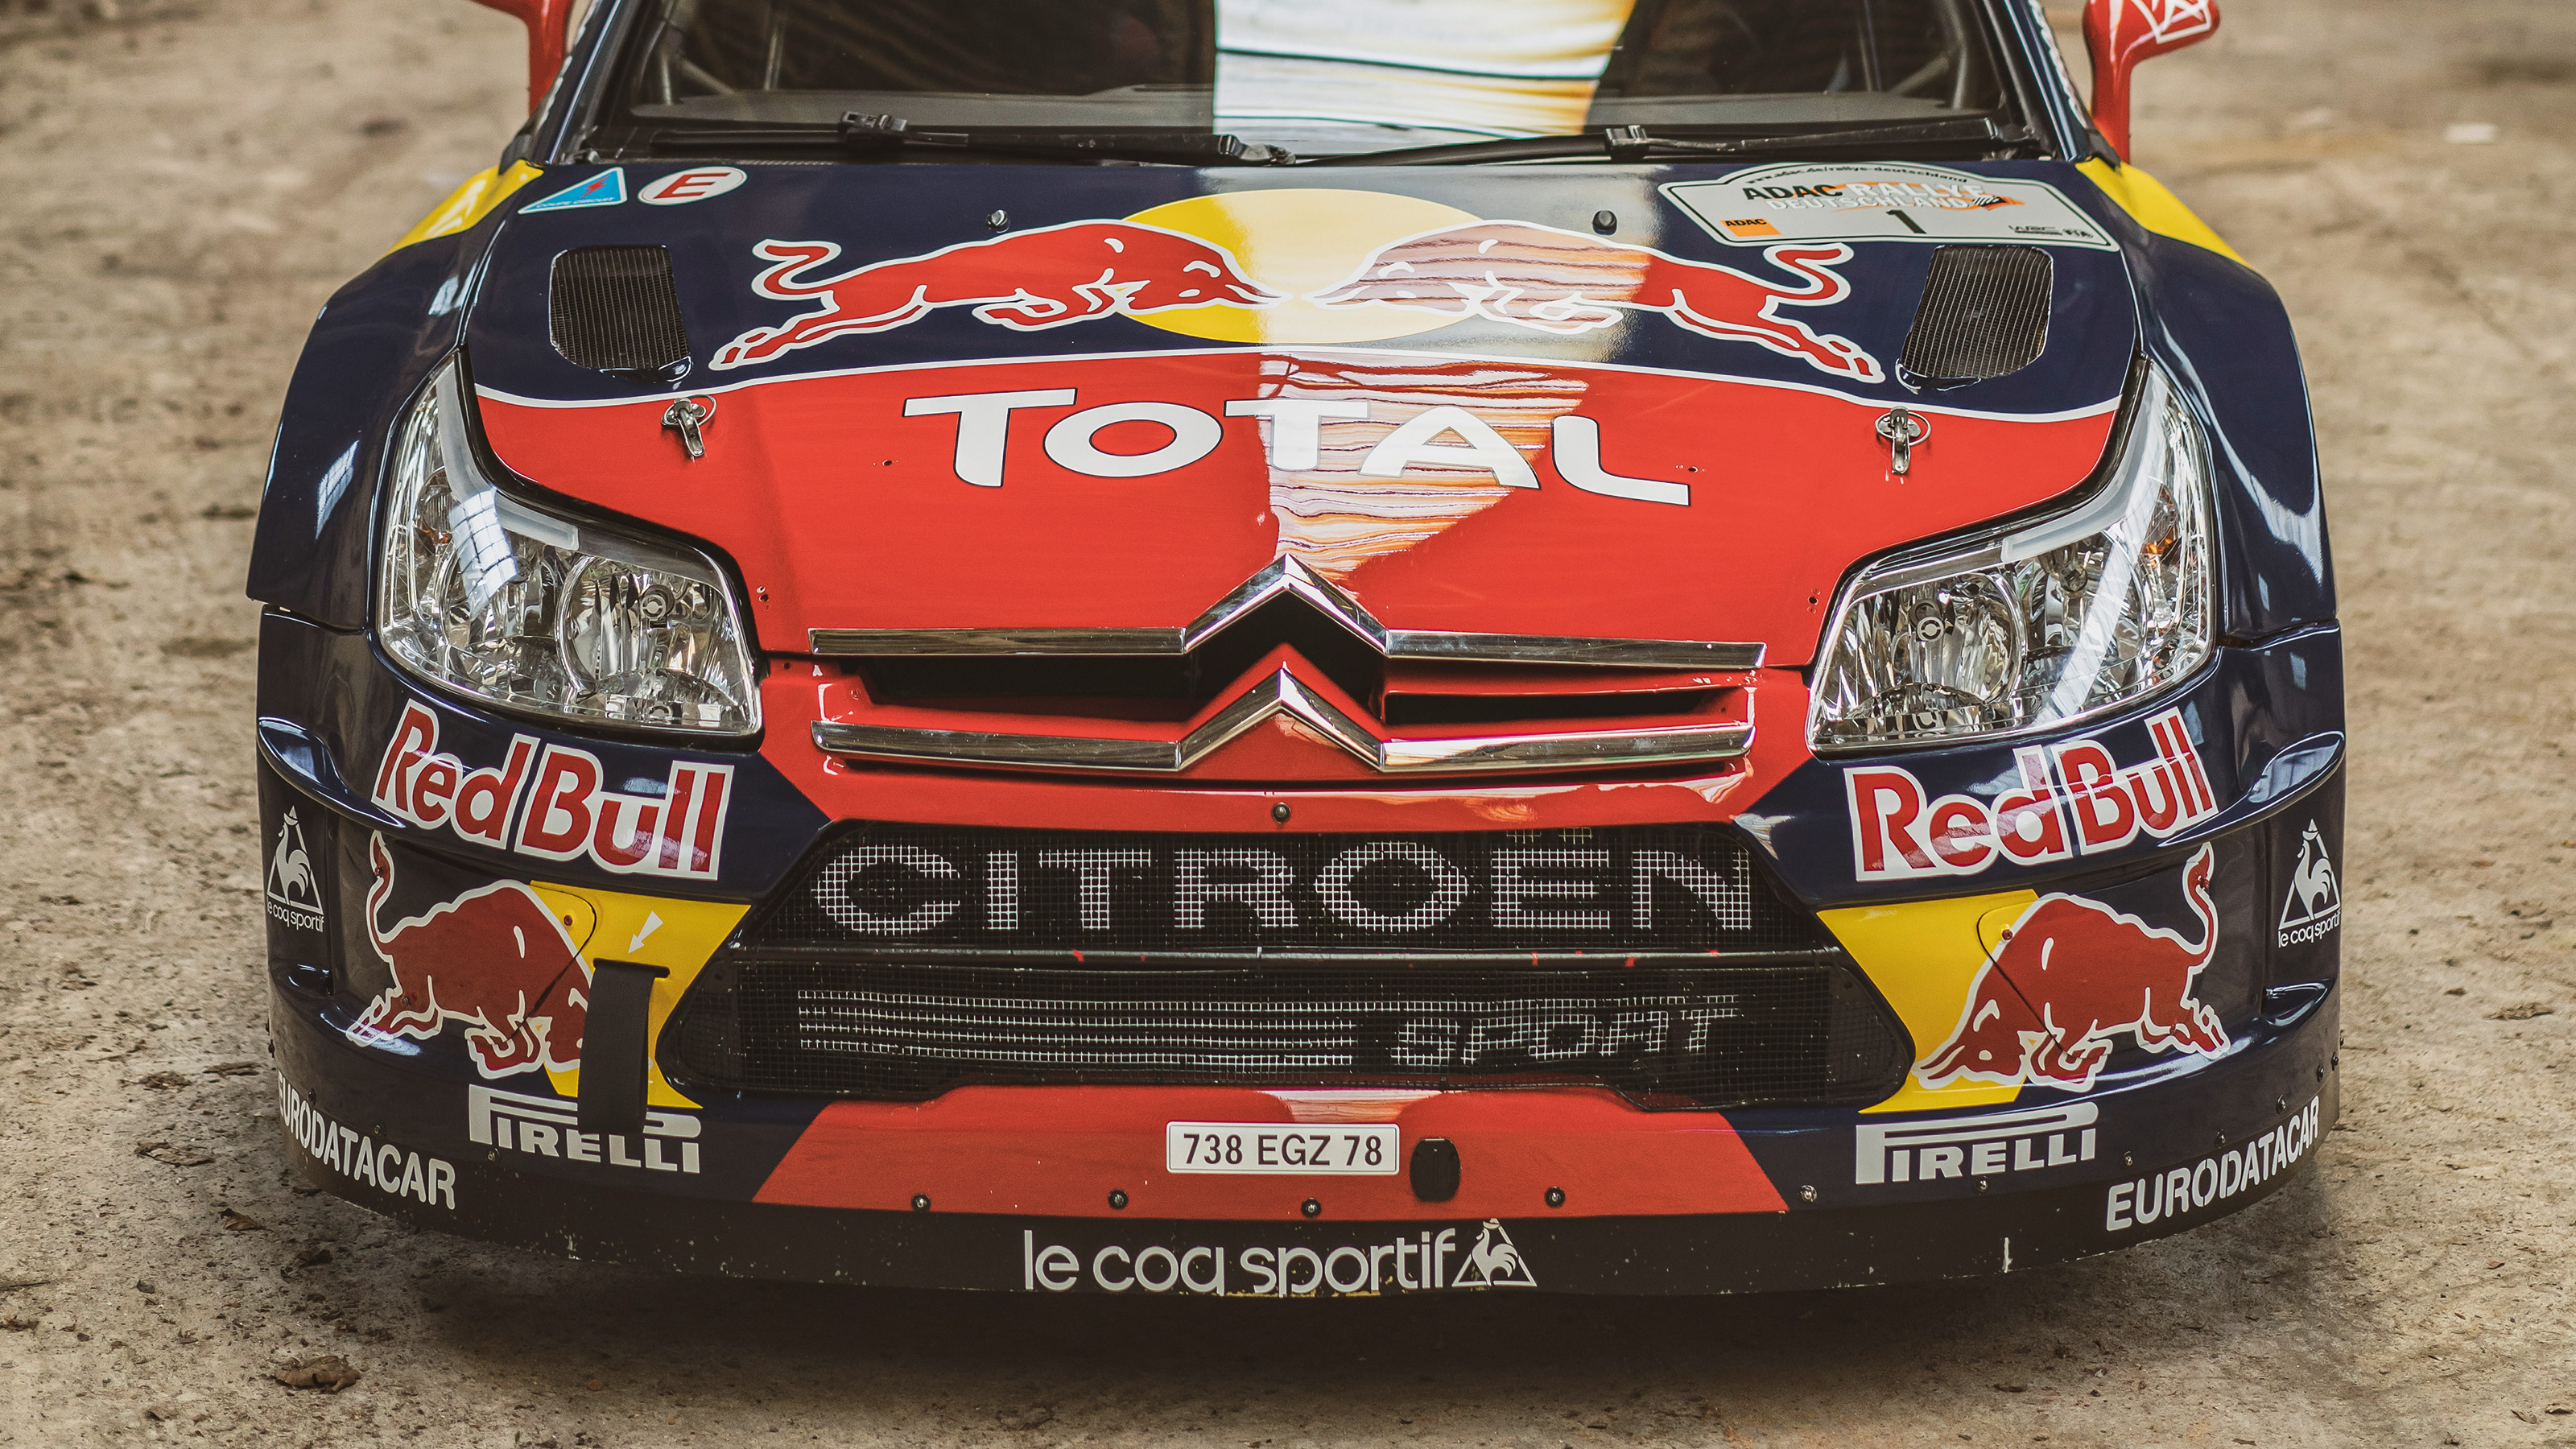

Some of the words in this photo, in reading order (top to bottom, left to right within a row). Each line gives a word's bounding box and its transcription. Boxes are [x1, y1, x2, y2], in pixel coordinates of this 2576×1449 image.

[653, 171, 732, 200] E
[1742, 183, 1843, 200] ADAC
[1845, 182, 1986, 199] RALLYE
[1765, 196, 1971, 212] DEUTSCHLAND
[1724, 218, 1768, 228] ADAC
[1885, 209, 1929, 235] 1
[903, 389, 1691, 506] TOTAL
[371, 699, 539, 849] Red
[514, 743, 734, 880] Bull
[1843, 745, 2073, 882] Red
[2055, 706, 2219, 856] Bull
[273, 904, 290, 927] coq
[291, 910, 324, 933] sportif
[2277, 930, 2289, 948] le
[2290, 925, 2314, 943] coq
[1391, 998, 1740, 1066] SPORT
[278, 1070, 456, 1211] EURODATACAR
[469, 1084, 701, 1174] PIRELLI
[1183, 1133, 1244, 1165] 738
[1257, 1133, 1331, 1166] EGZ
[1344, 1134, 1383, 1166] 78
[1856, 1101, 2099, 1185] PIRELLI
[2107, 1095, 2319, 1232] EURODATACAR
[1024, 1229, 1080, 1291] le
[1092, 1245, 1224, 1296] coq
[1240, 1228, 1455, 1298] sportif
